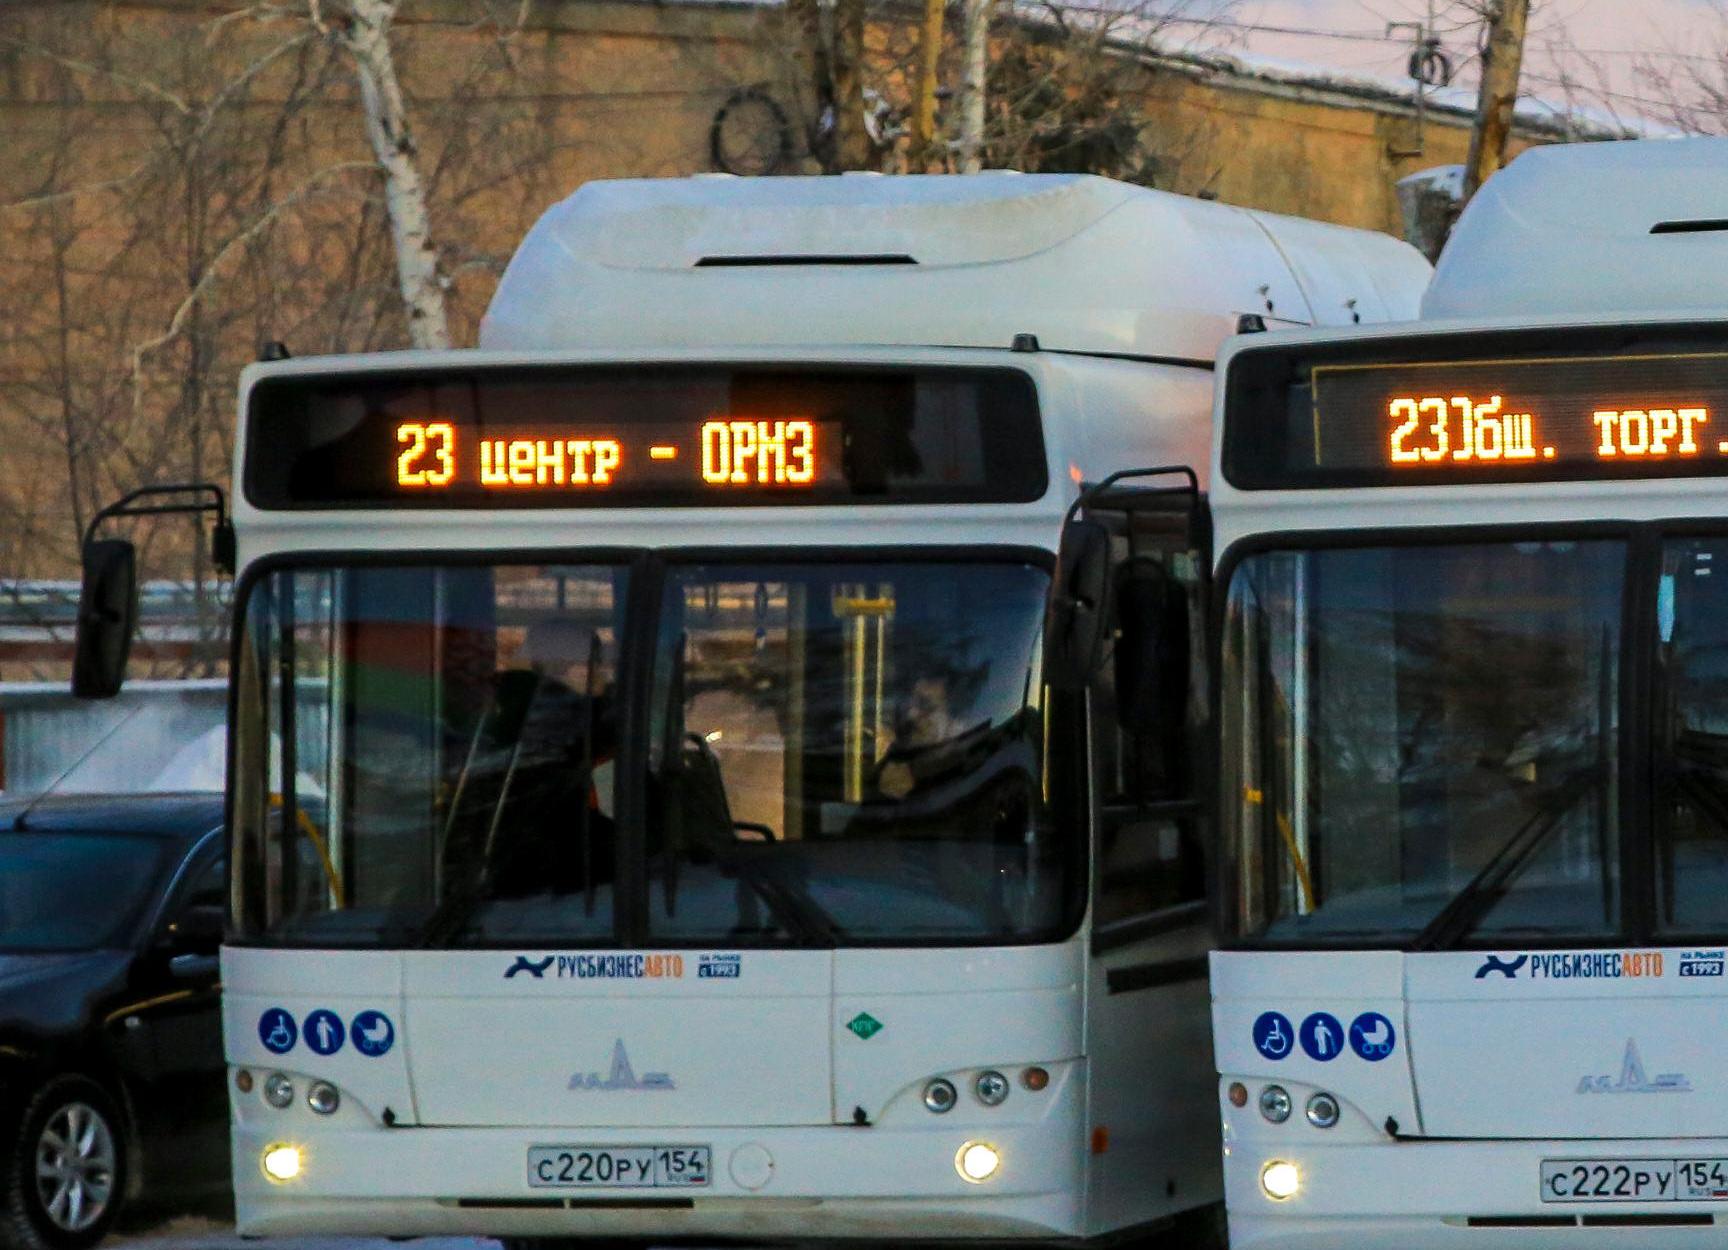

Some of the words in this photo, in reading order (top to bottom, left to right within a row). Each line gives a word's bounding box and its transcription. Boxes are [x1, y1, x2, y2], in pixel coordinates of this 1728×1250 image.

[398, 422, 454, 486] 23
[480, 440, 620, 485] центр
[702, 421, 814, 483] ОРМЗ
[557, 954, 683, 978] РУСБИЗНЕСАВТО
[1531, 953, 1663, 978] РУСБИЗНЕСАВТО
[659, 1150, 704, 1172] 154
[1679, 1162, 1725, 1187] 154
